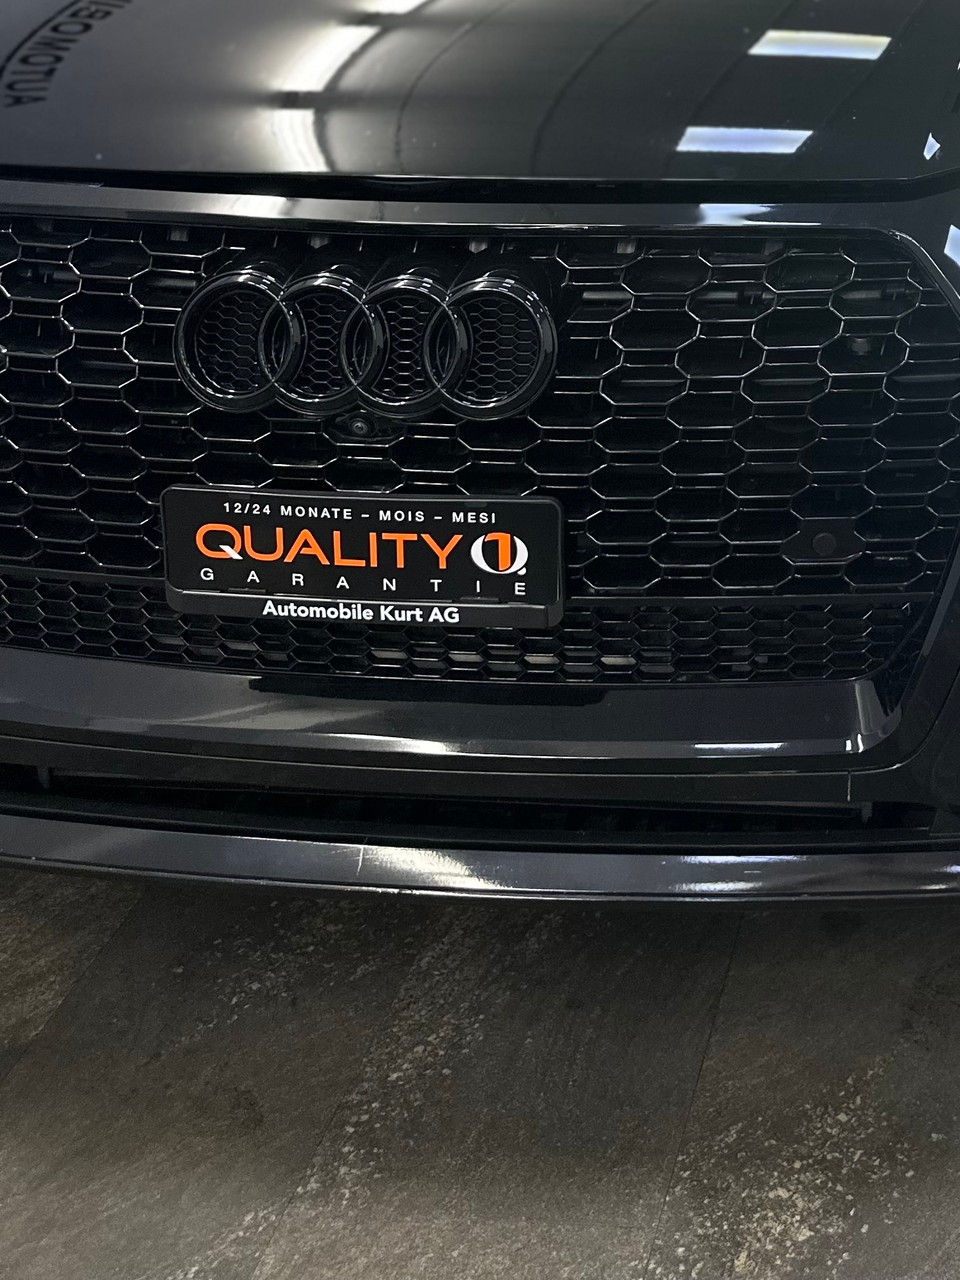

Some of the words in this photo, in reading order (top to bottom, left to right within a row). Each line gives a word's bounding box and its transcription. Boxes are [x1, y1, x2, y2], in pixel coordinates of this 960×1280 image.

[223, 502, 271, 515] 12/24
[280, 505, 353, 520] MONATE
[379, 510, 425, 523] MOIS
[452, 512, 496, 524] MESI
[195, 523, 463, 570] QUALITY
[200, 568, 526, 596] GARANTIE
[262, 599, 374, 621] Automobile
[380, 605, 424, 623] Kurt
[428, 607, 460, 623] AG
